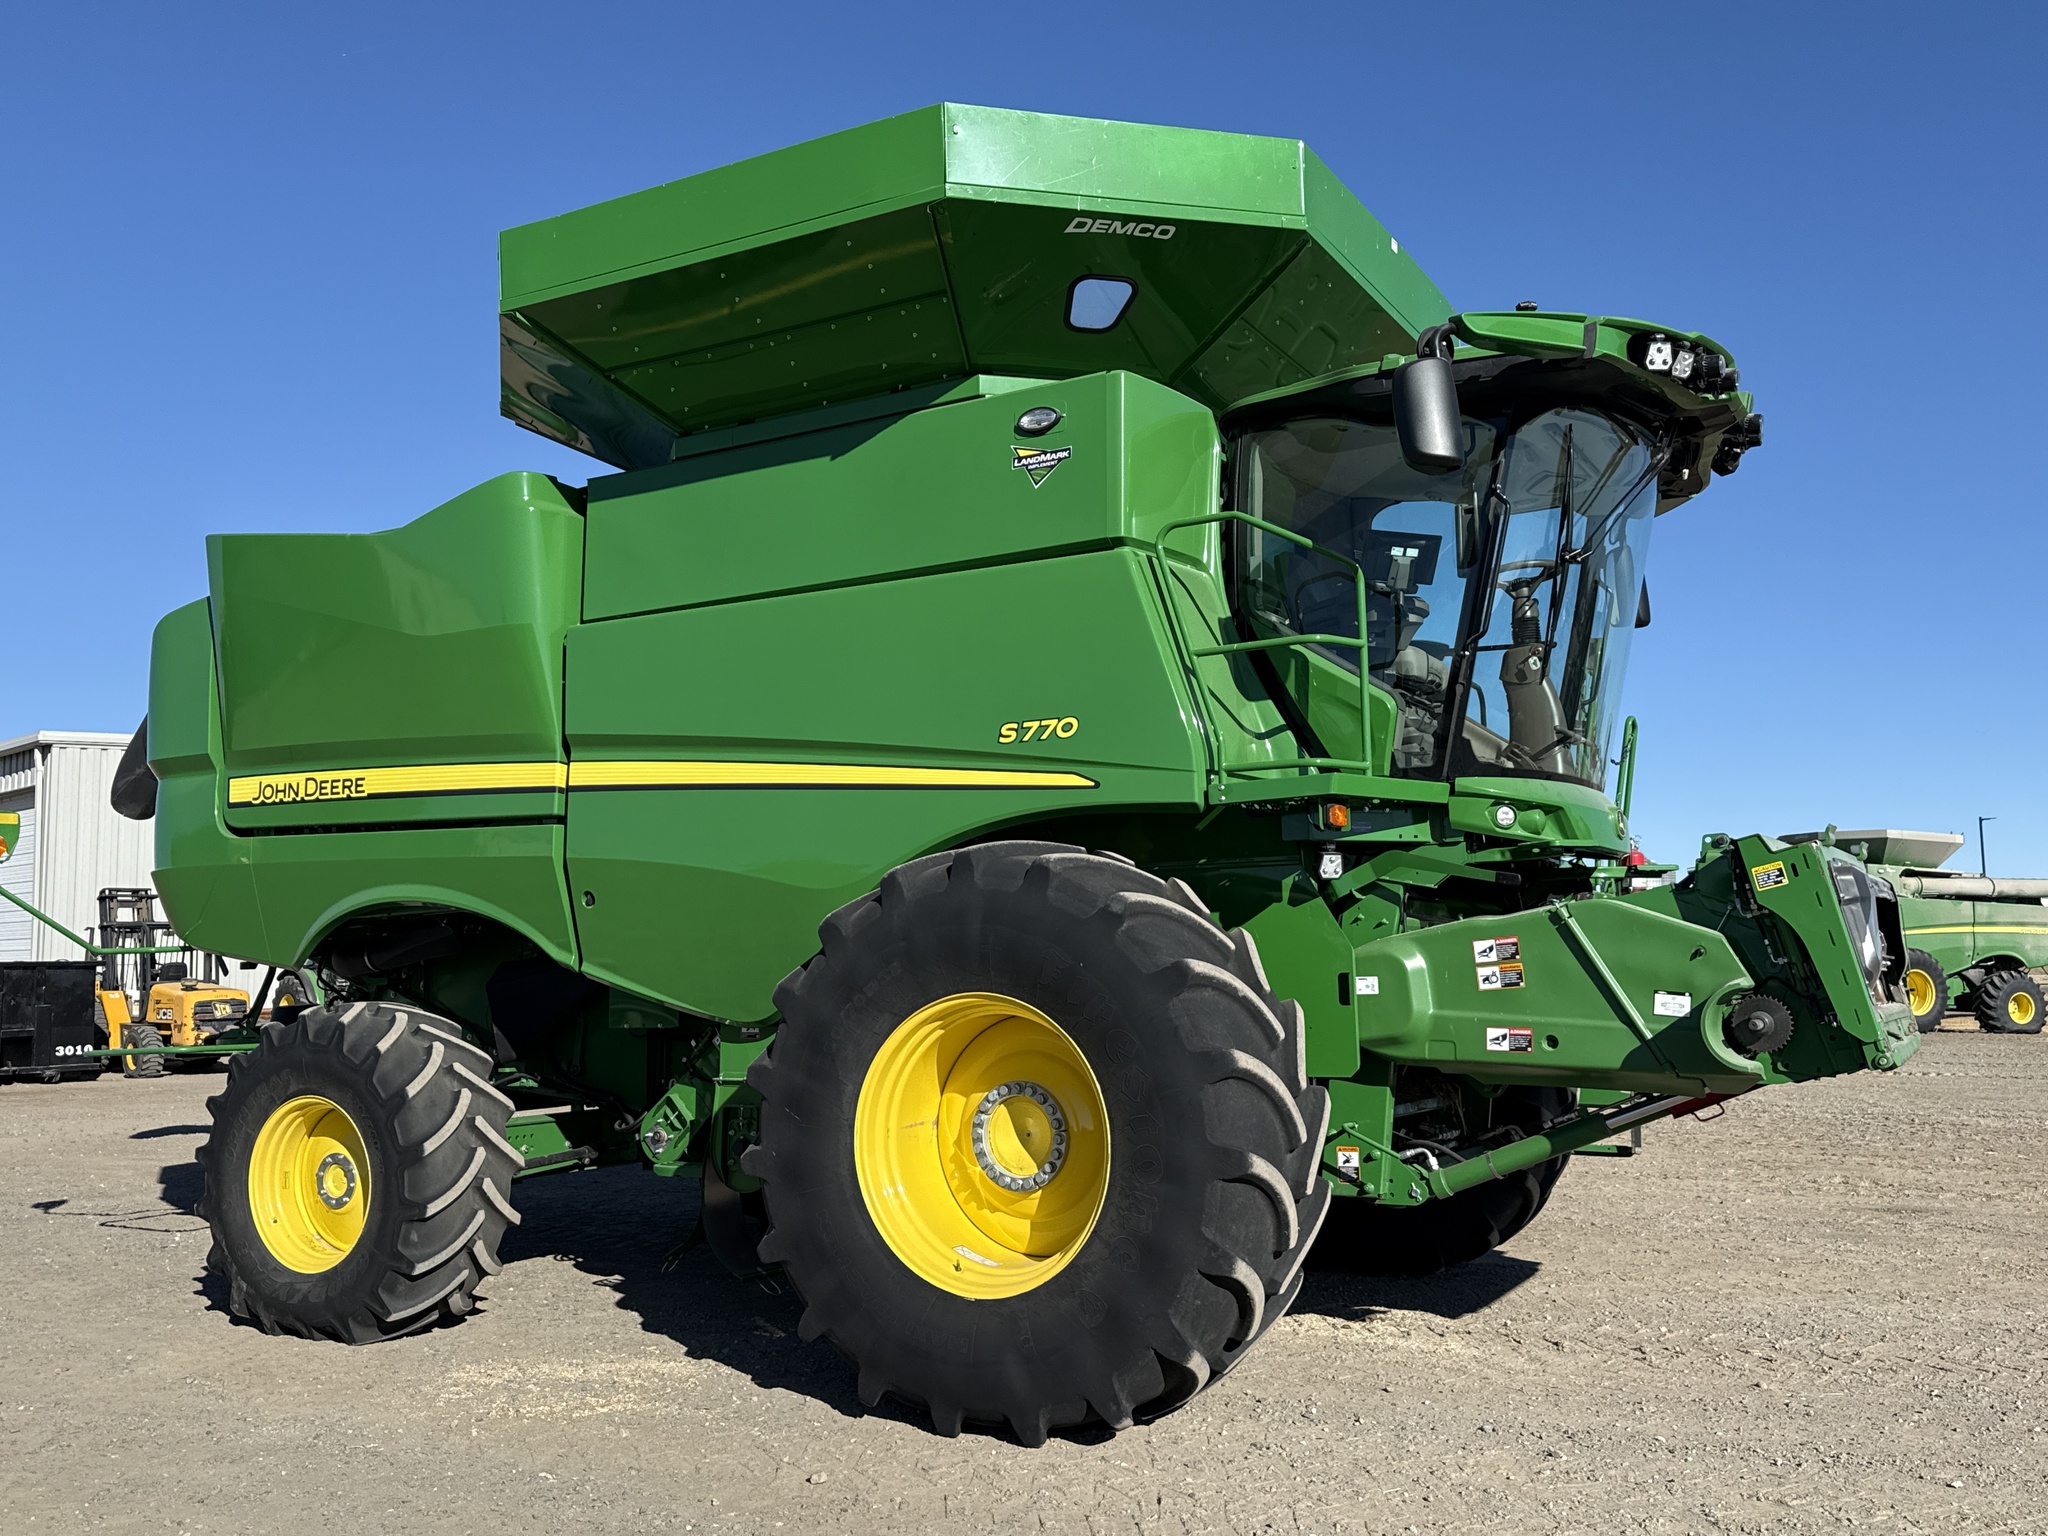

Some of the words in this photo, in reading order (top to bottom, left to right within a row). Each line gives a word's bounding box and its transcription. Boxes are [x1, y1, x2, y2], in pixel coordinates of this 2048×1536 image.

[1064, 217, 1176, 240] DEMCO
[998, 716, 1079, 744] S770
[251, 781, 300, 801] JOHN
[304, 777, 366, 798] DEERE
[156, 1008, 173, 1020] JCB
[214, 1003, 232, 1018] JCB
